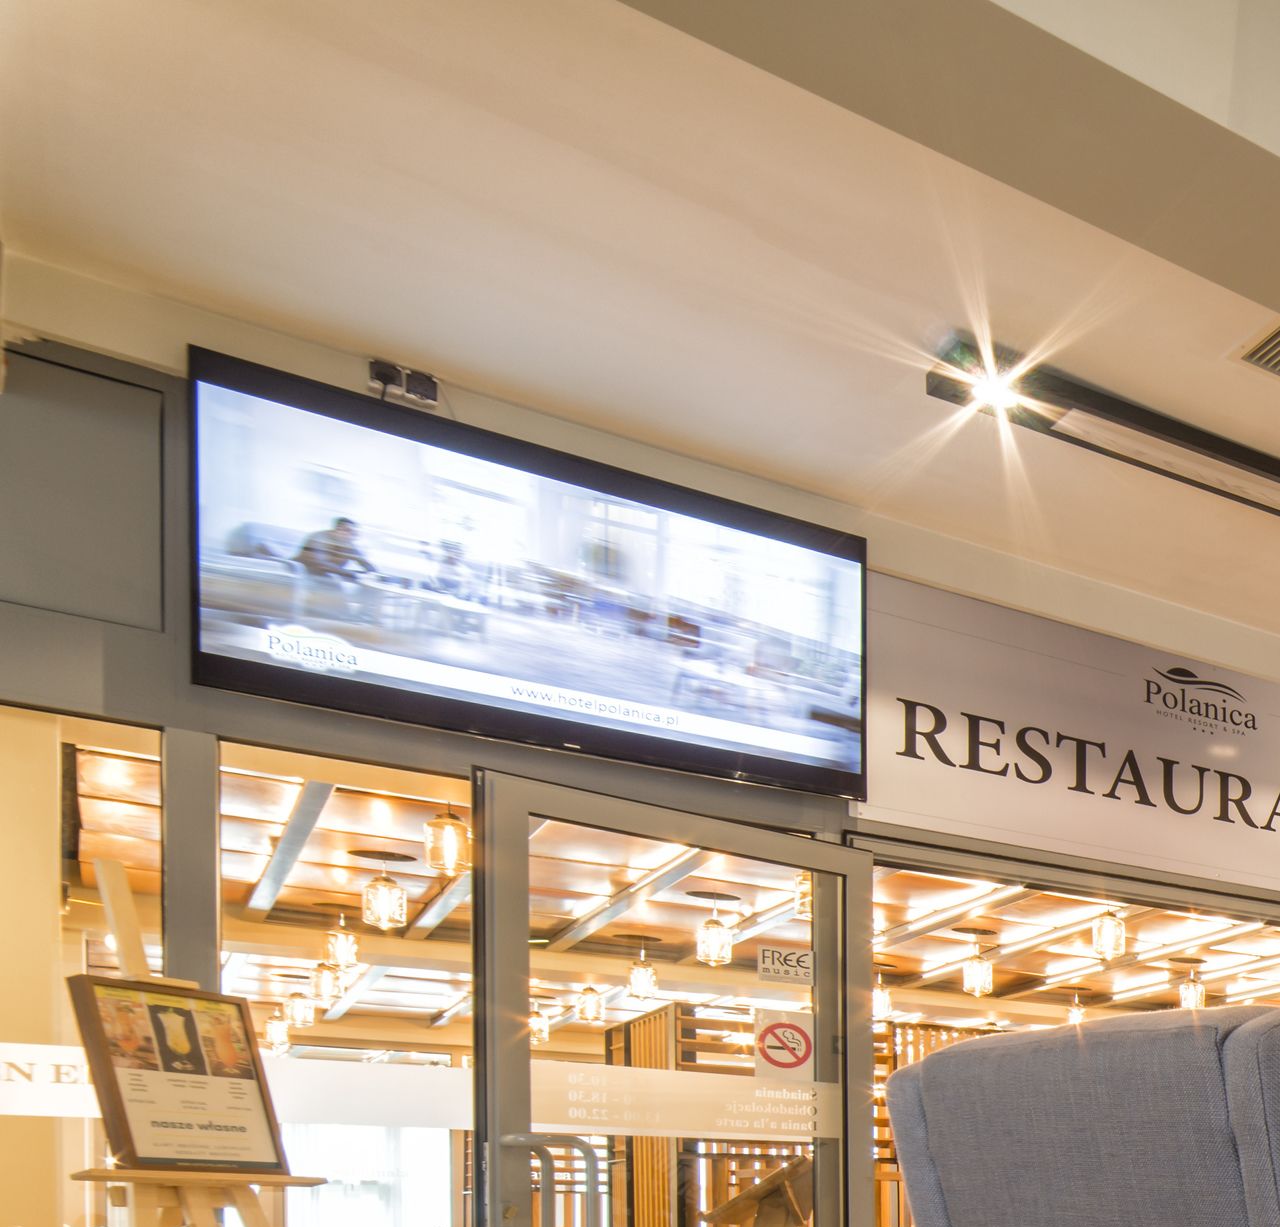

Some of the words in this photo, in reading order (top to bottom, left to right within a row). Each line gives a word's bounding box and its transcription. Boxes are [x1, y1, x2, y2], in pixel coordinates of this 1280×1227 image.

[267, 633, 358, 665] Polanica
[511, 686, 680, 726] www.hotelpolanica.pl
[1143, 679, 1258, 730] Polanica
[1156, 709, 1183, 721] HOTEL
[1188, 718, 1218, 730] RESORT
[1232, 728, 1246, 736] SPA
[762, 949, 810, 969] FREE
[762, 967, 810, 977] music
[150, 1120, 194, 1130] nasze
